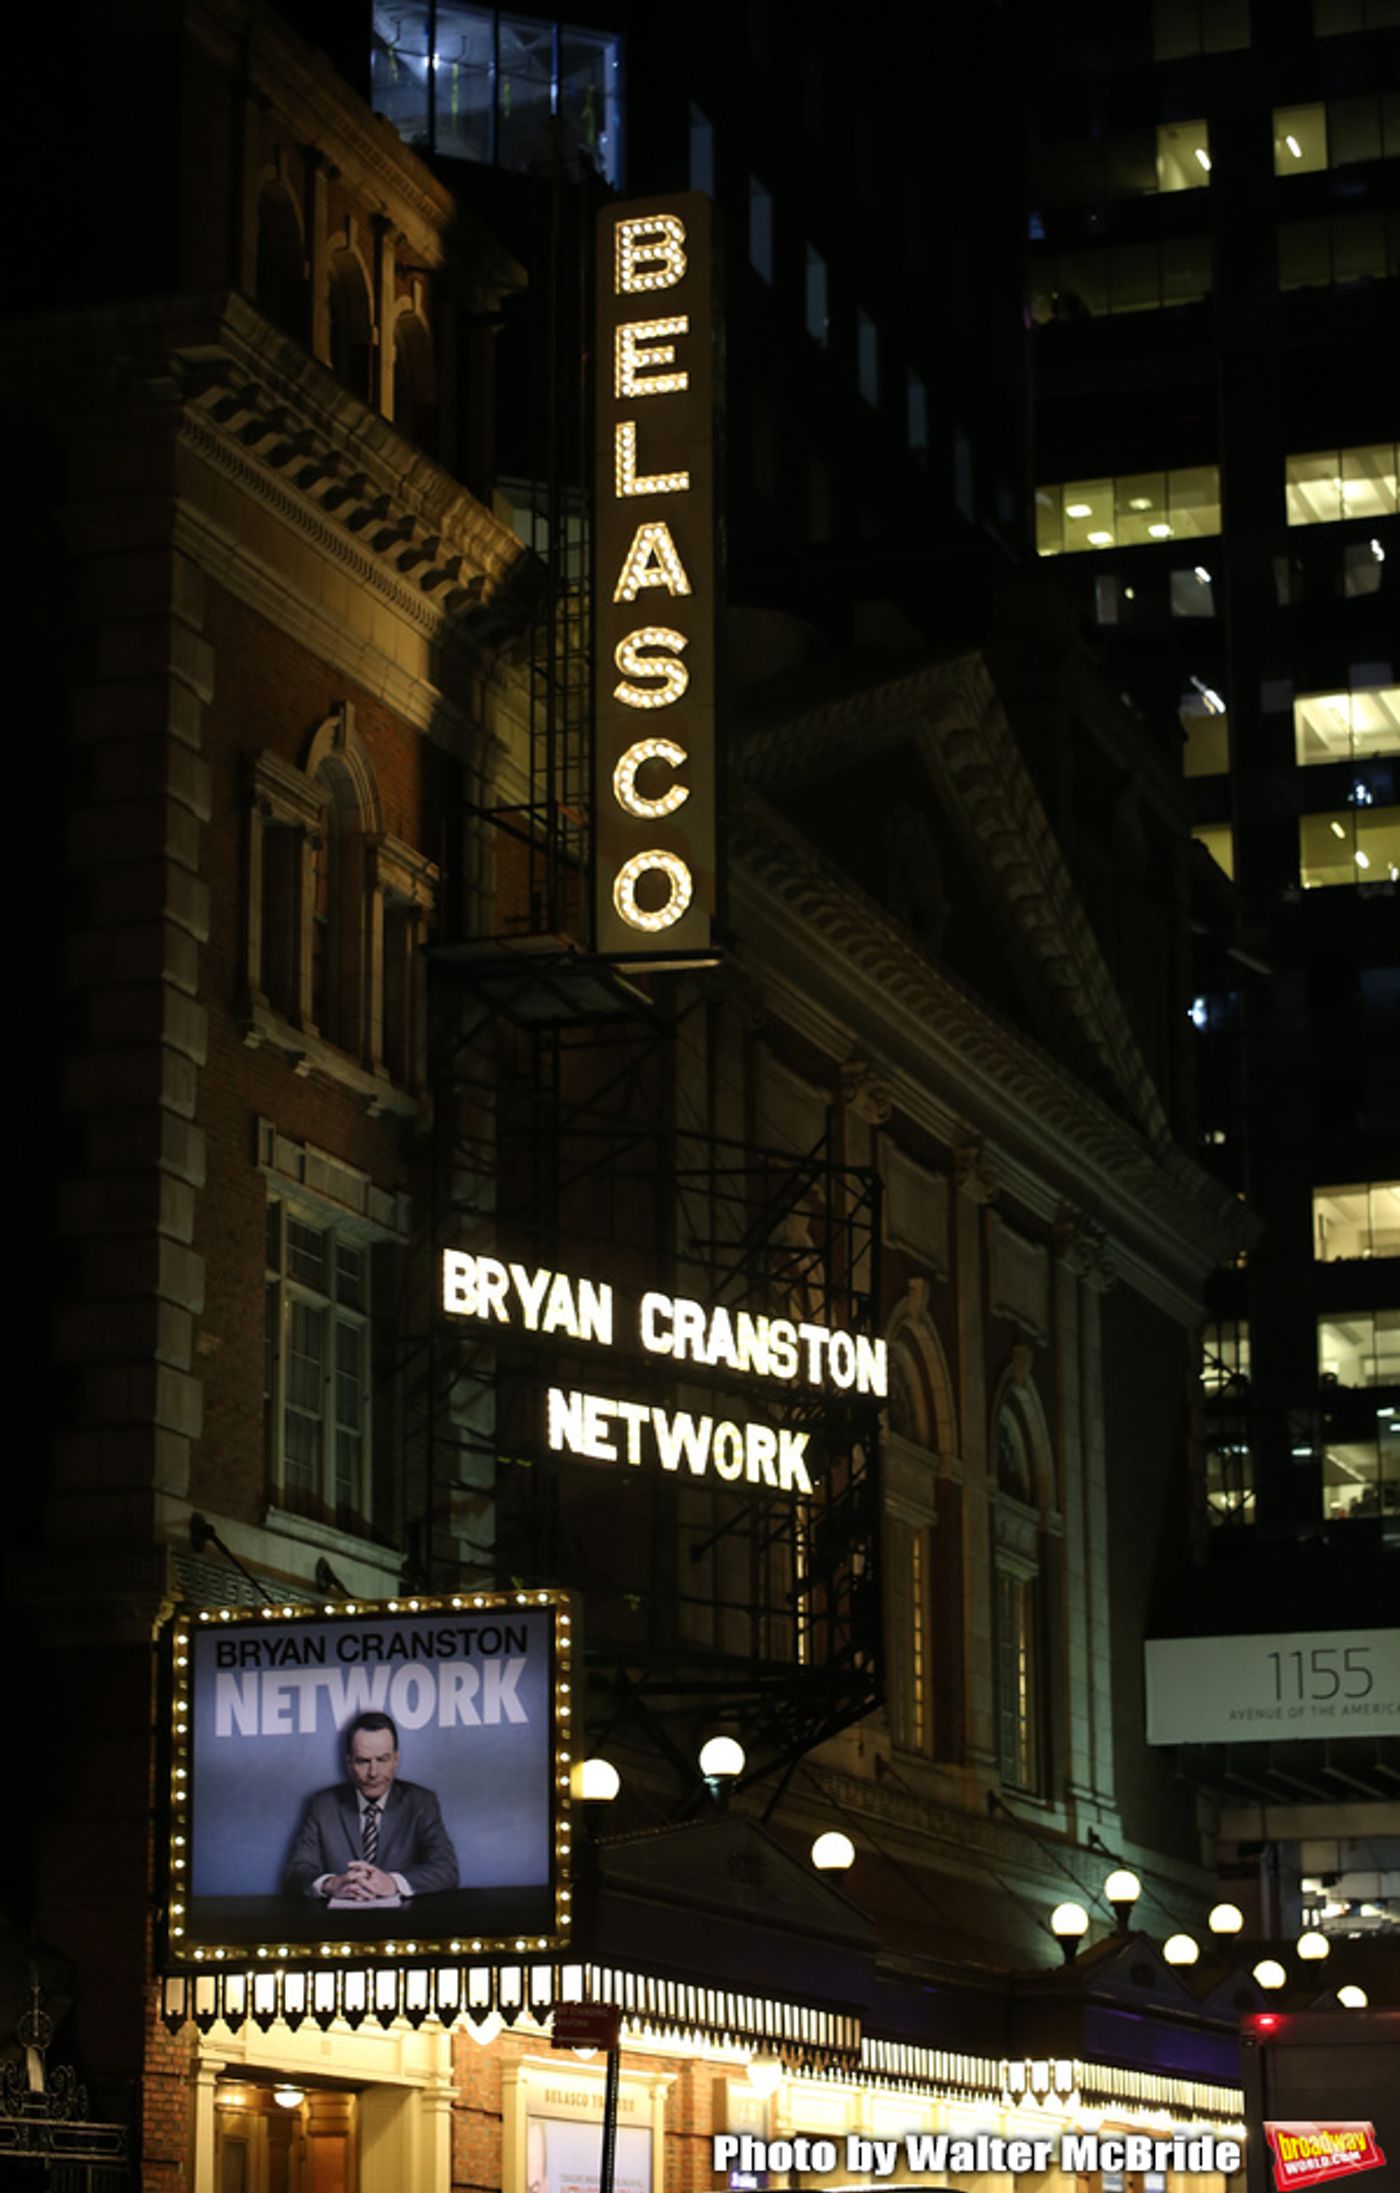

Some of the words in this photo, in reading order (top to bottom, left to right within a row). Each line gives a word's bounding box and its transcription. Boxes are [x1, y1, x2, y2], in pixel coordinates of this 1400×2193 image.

[613, 213, 692, 932] BELASCO
[443, 1248, 612, 1345] BRYAN
[641, 1292, 888, 1397] CRANSTON
[548, 1388, 812, 1494] NETWORK
[215, 1636, 325, 1668] BRYAN
[336, 1625, 528, 1662] CRANSTON
[1267, 1647, 1373, 1700] 1155
[215, 1657, 528, 1738] NETWORK
[1229, 1707, 1282, 1721] AVENUE
[1288, 1706, 1304, 1719] OF
[1311, 1705, 1335, 1717] THE
[544, 2088, 589, 2108] BELASCO
[592, 2094, 635, 2112] THRE
